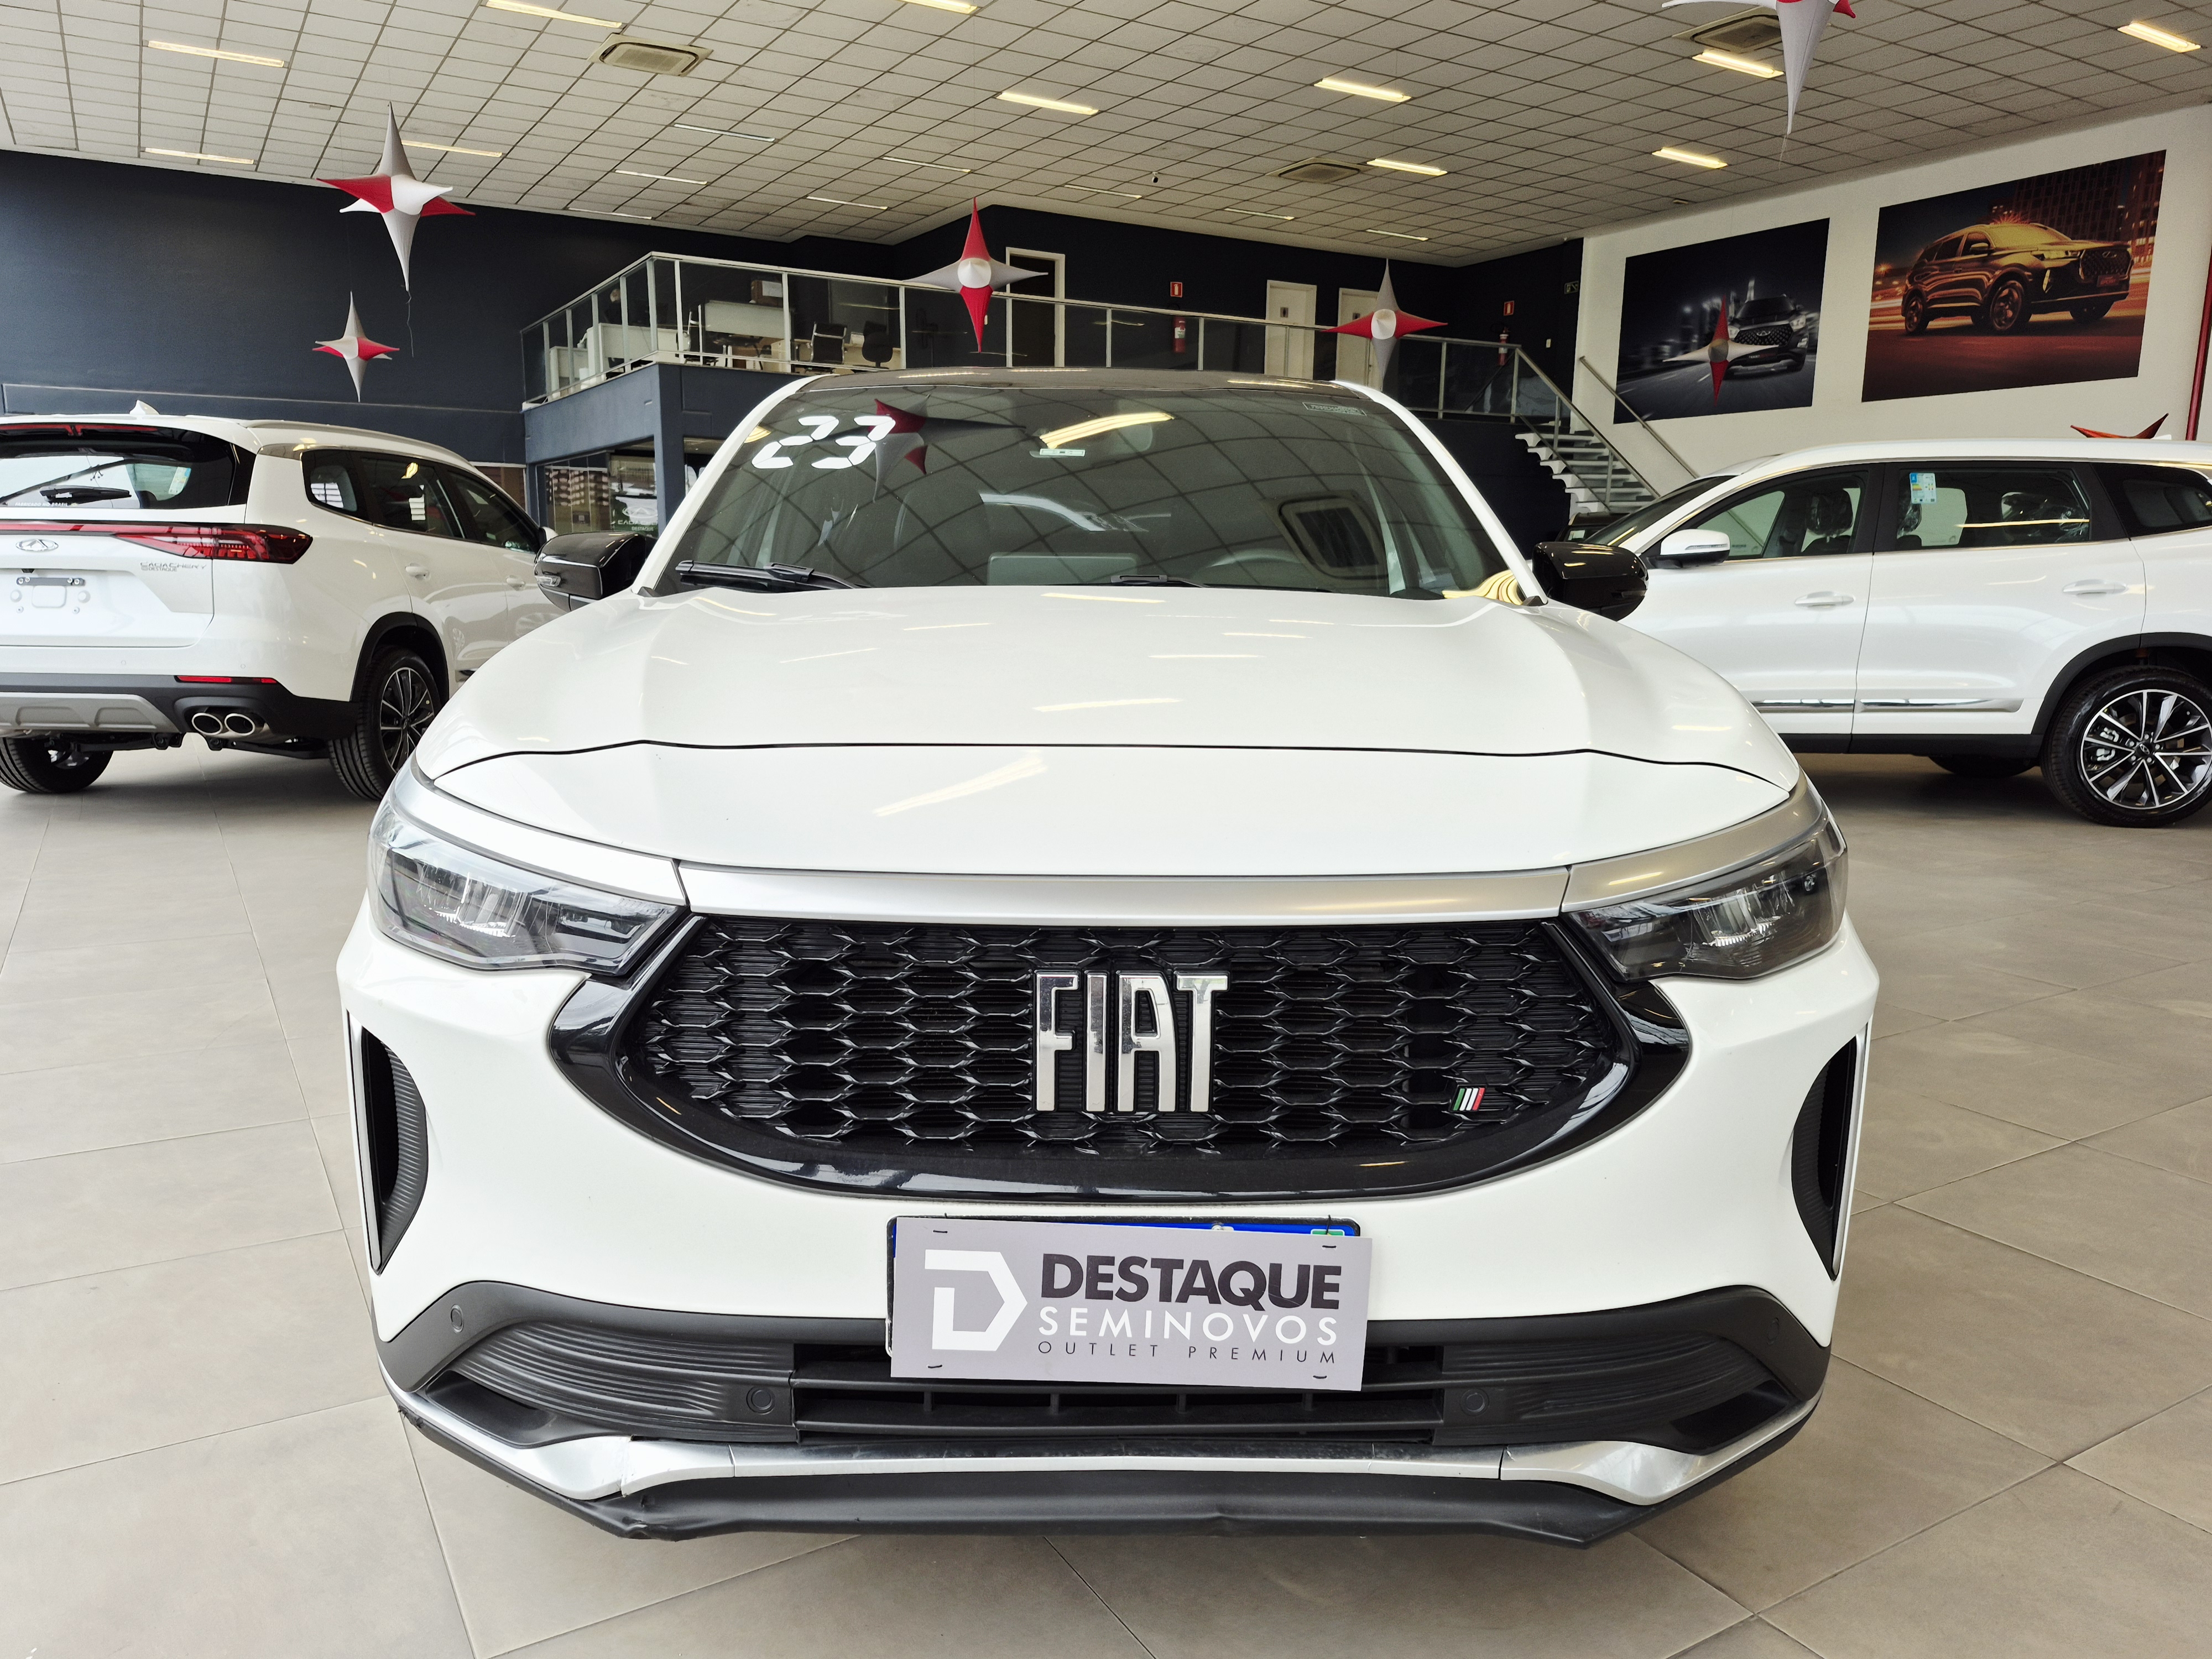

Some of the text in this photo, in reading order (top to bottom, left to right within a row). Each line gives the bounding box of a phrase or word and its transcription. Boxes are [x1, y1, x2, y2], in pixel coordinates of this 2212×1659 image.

[752, 415, 896, 469] 23
[1035, 973, 1229, 1112] FIAT
[1041, 1254, 1342, 1311] DESTAQUE
[1038, 1341, 1334, 1364] OUTLET PREMIUM
[1039, 1306, 1337, 1345] SEMINOVOS
